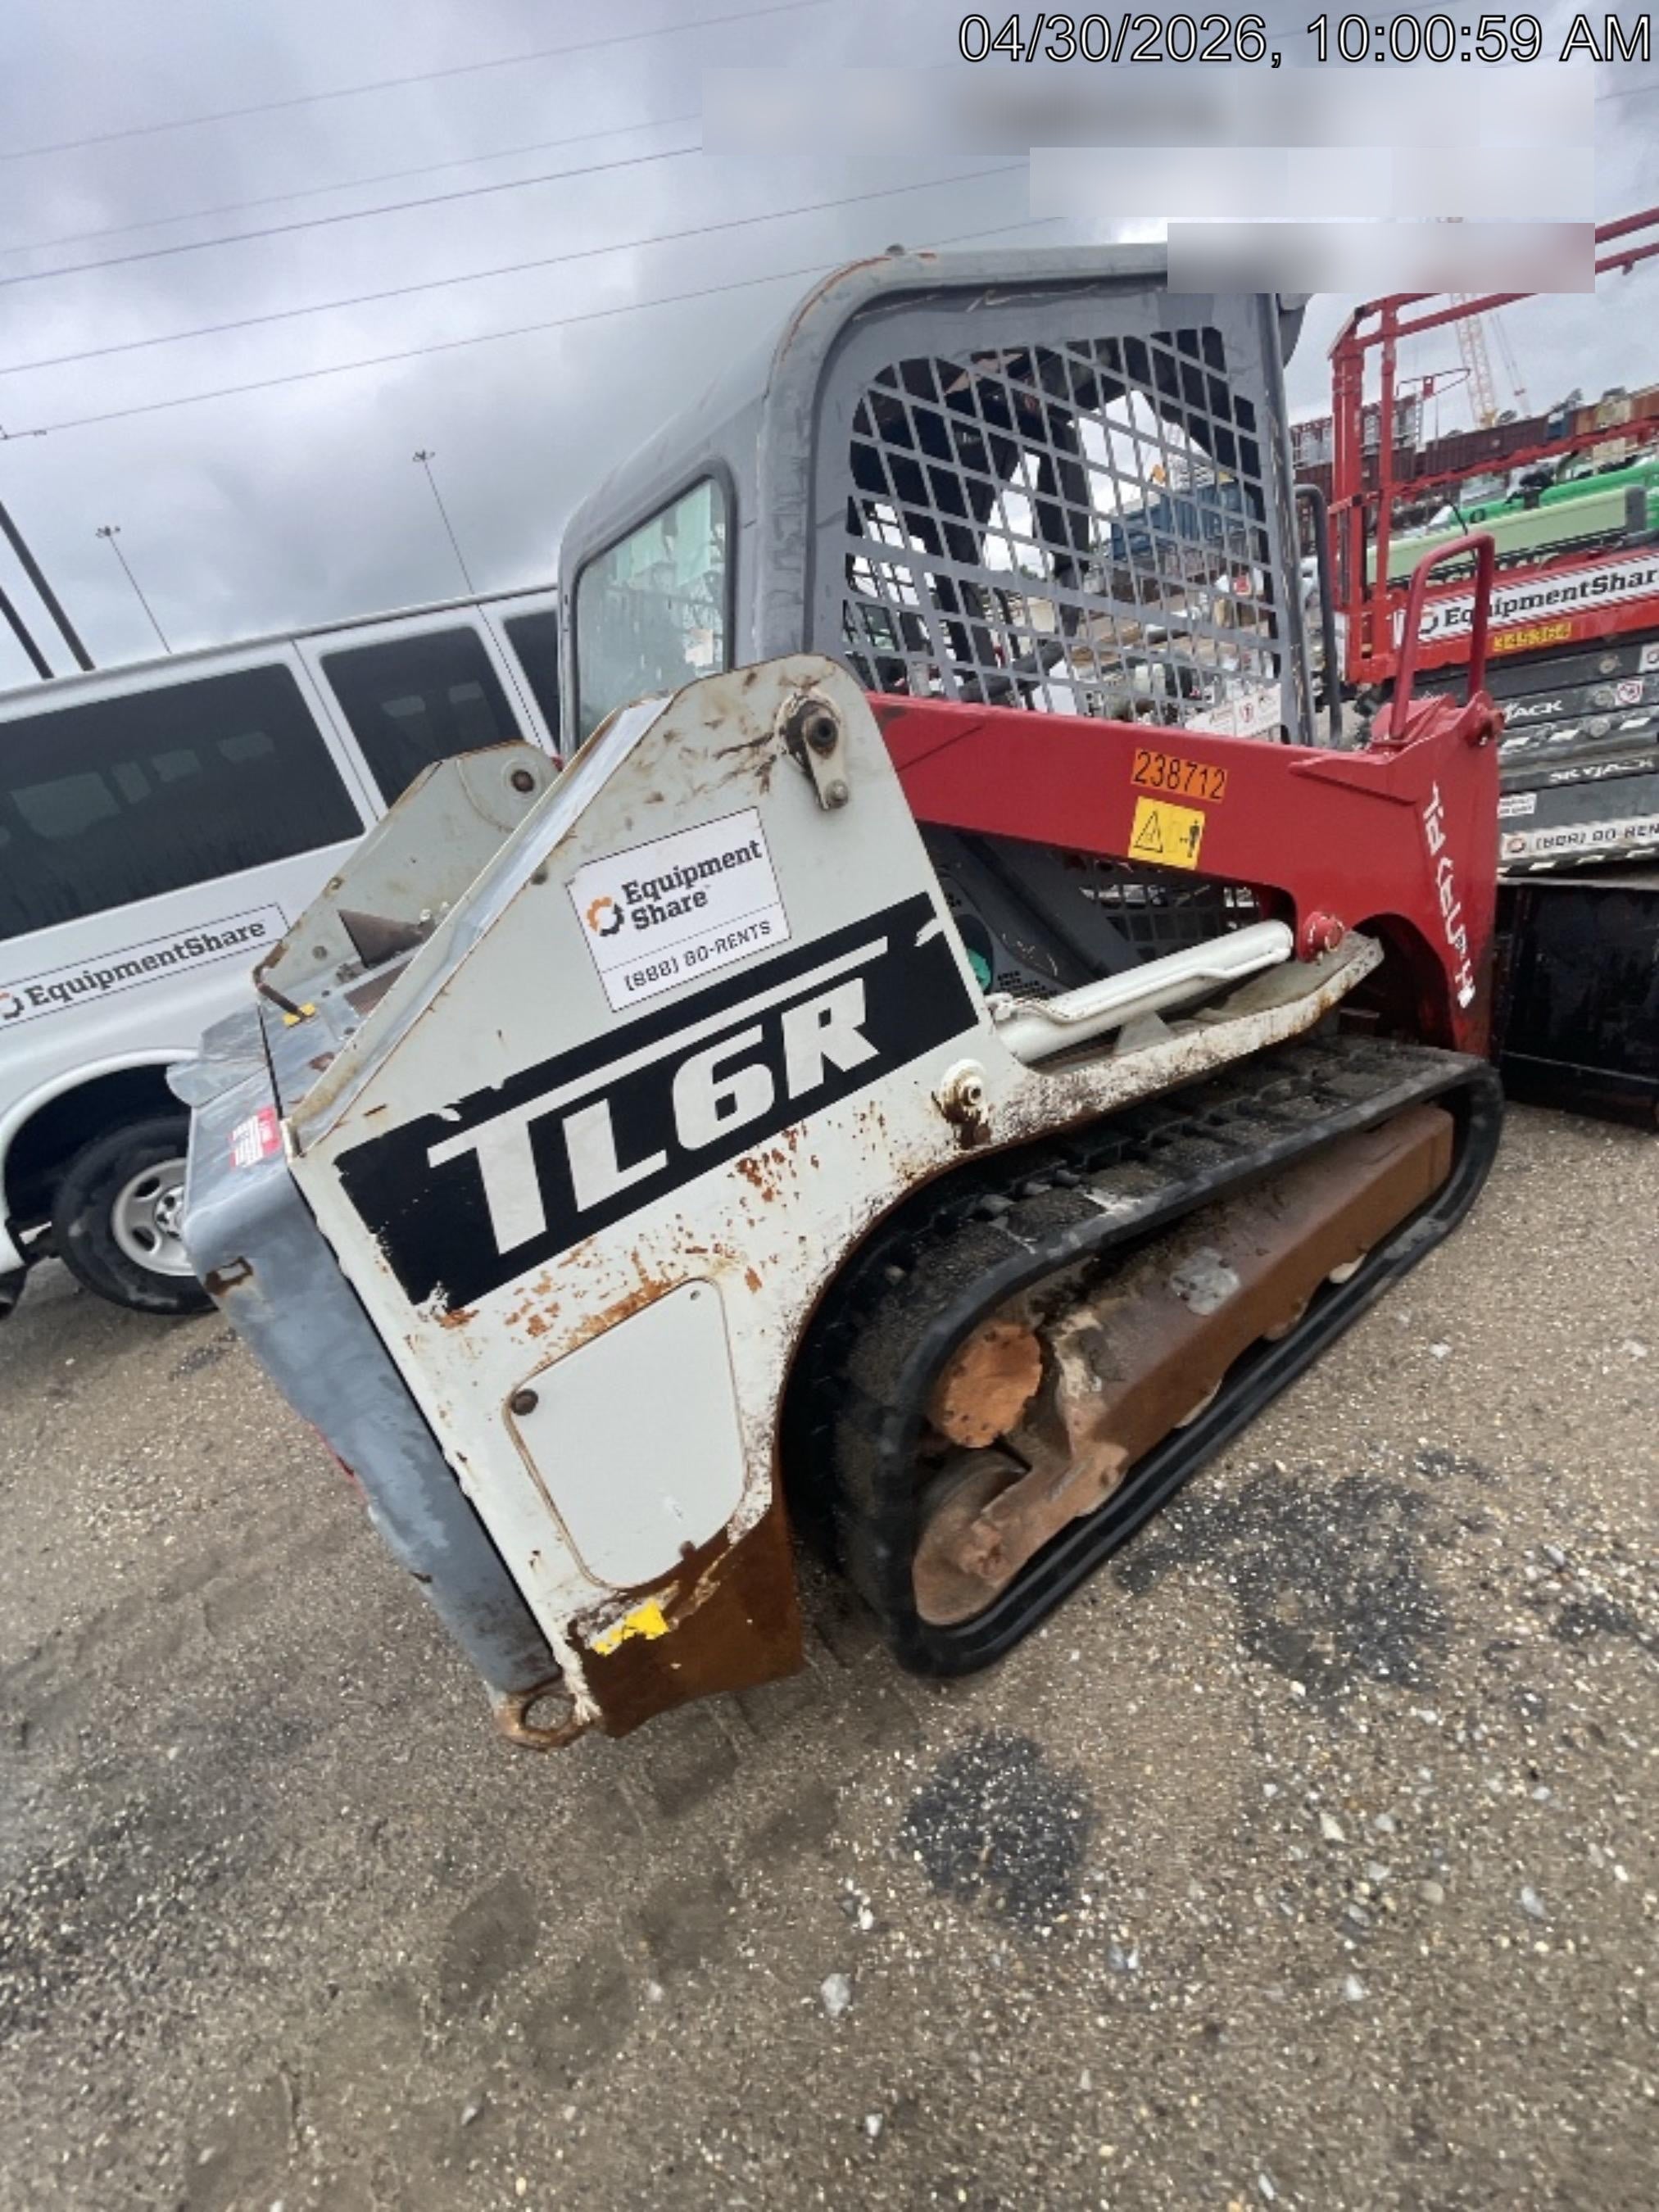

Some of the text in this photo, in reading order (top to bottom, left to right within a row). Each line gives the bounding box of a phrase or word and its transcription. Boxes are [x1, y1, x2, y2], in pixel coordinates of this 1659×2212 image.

[1444, 569, 1658, 627] EqipmentShar
[1133, 750, 1226, 800] 238712
[620, 839, 763, 905] Equipment
[630, 890, 709, 931] Share
[24, 922, 266, 1007] EquipmentShare
[623, 920, 772, 991] (888) GO-RENTS
[426, 936, 889, 1255] TL6R
